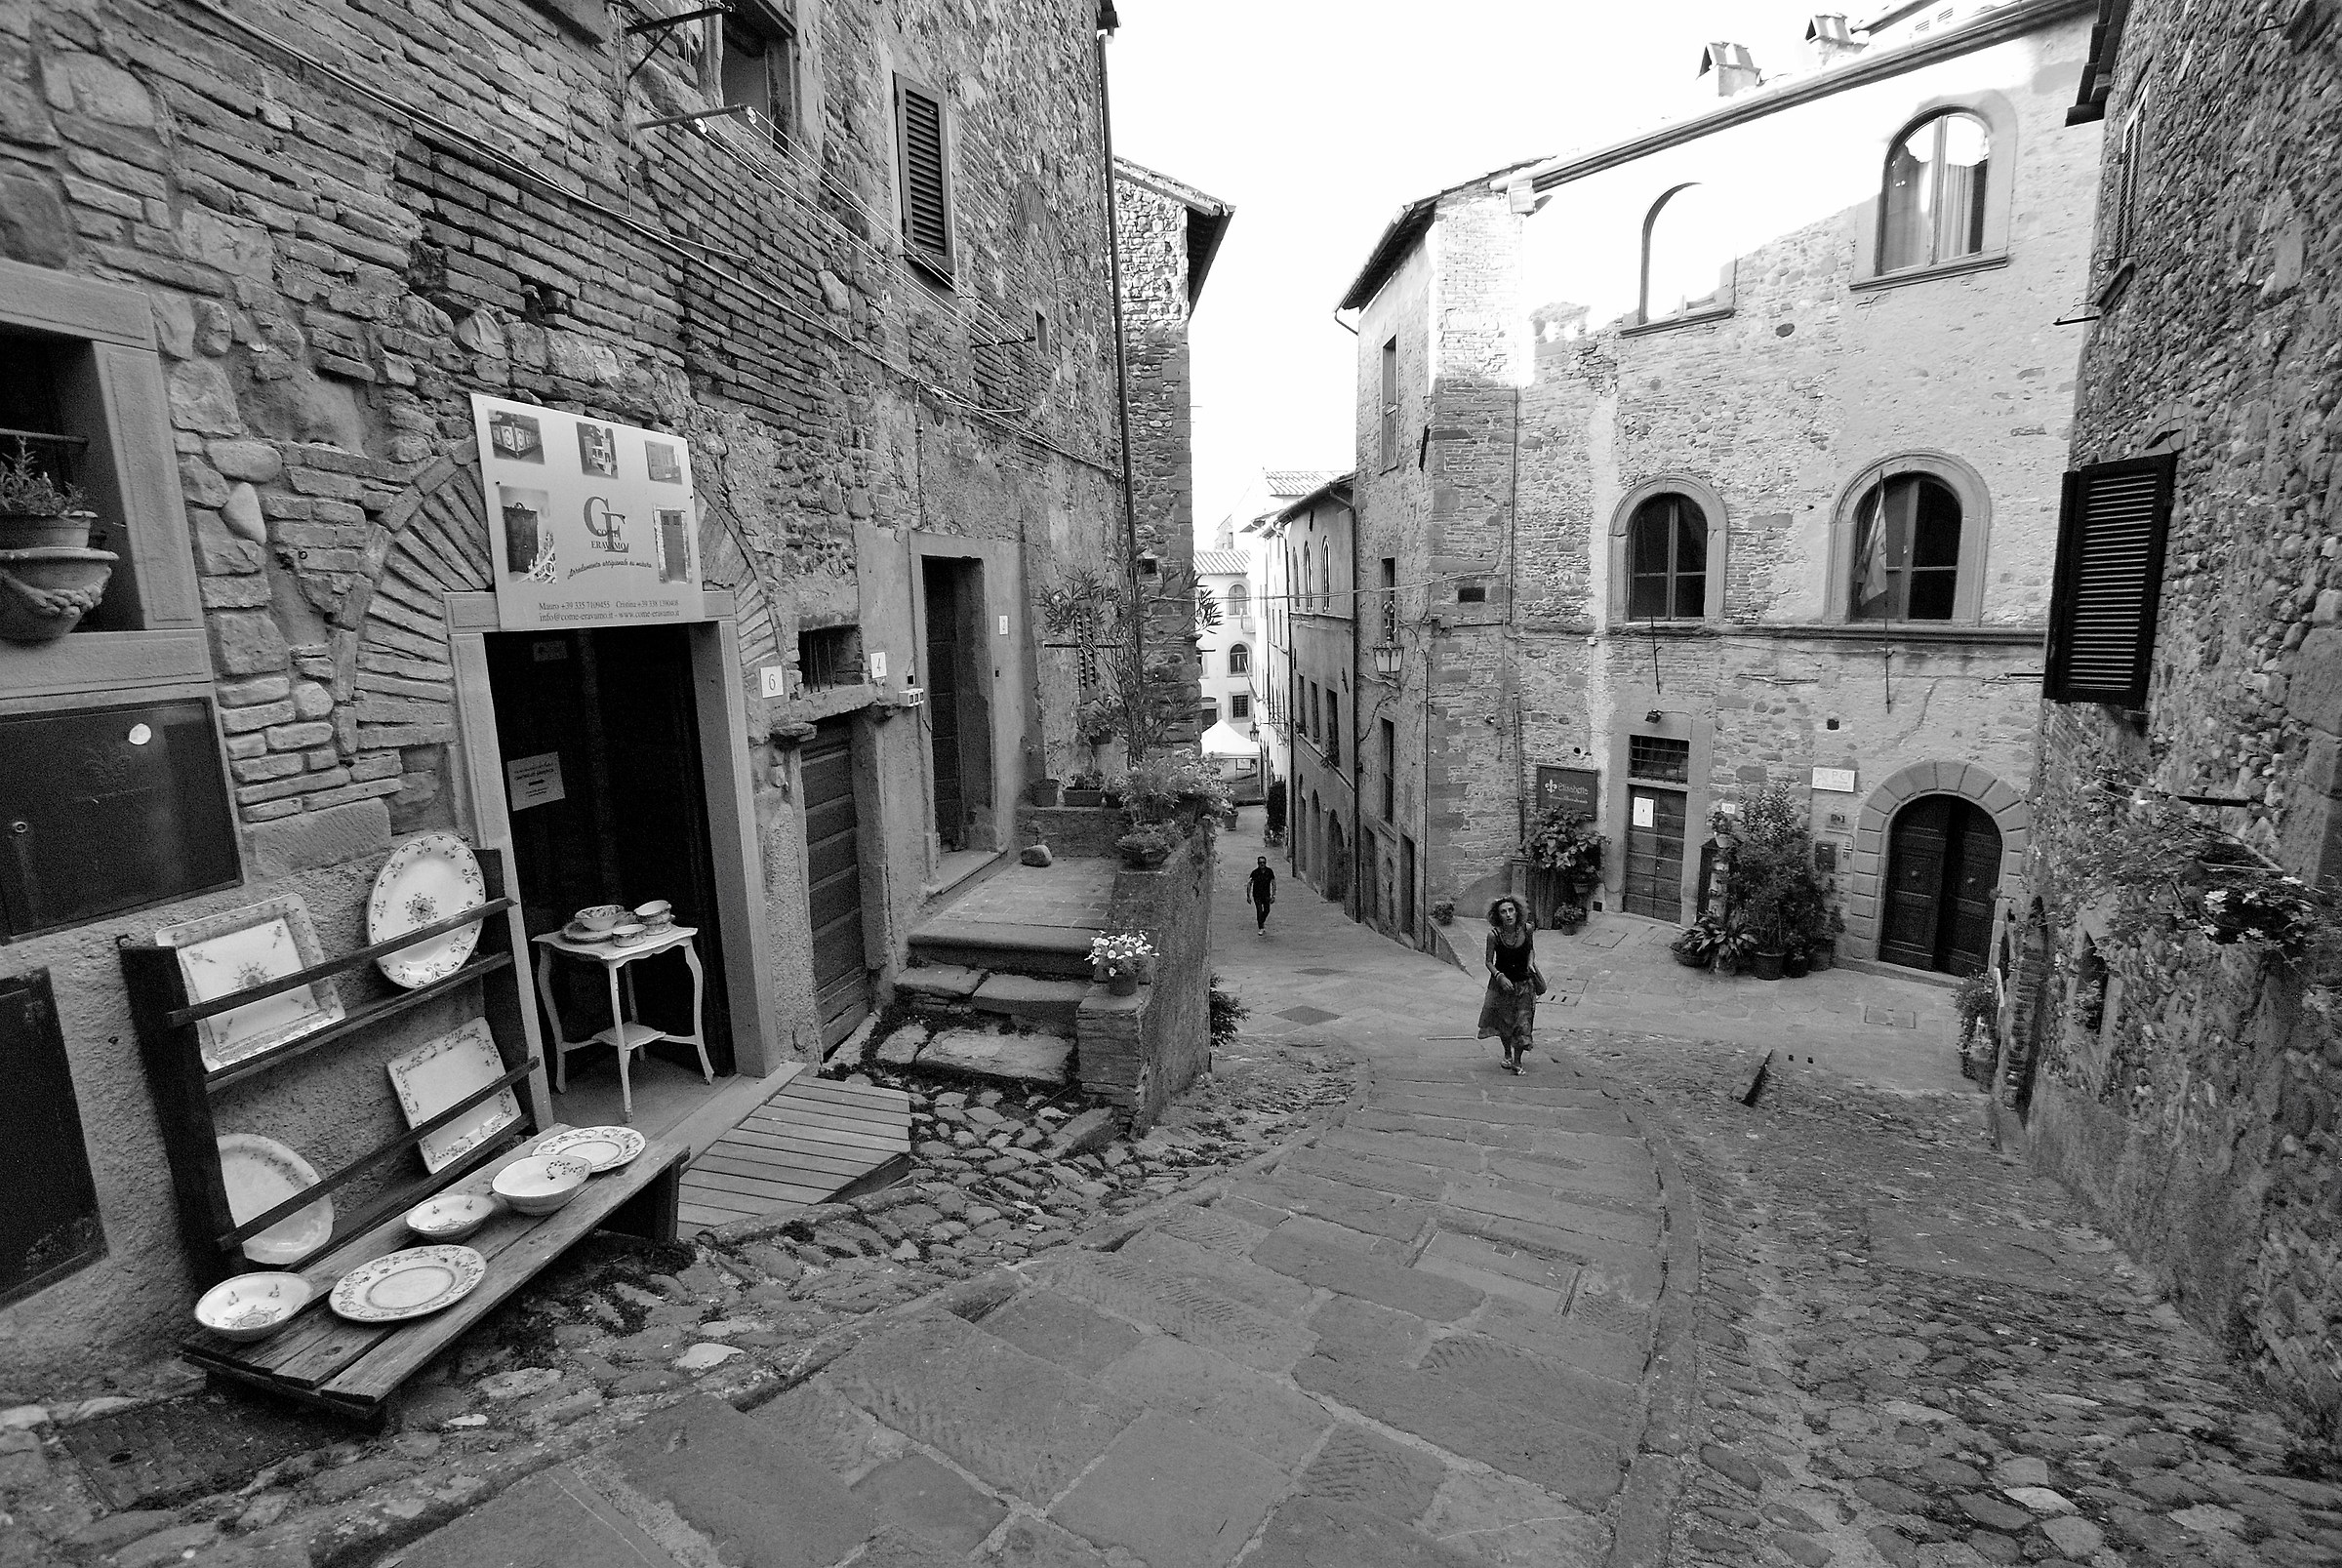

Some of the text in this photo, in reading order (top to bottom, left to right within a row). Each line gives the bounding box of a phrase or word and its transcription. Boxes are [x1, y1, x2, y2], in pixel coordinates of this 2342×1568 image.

[539, 602, 559, 611] Mauro
[561, 601, 574, 610] +39
[575, 601, 586, 610] 335
[768, 673, 776, 691] 6
